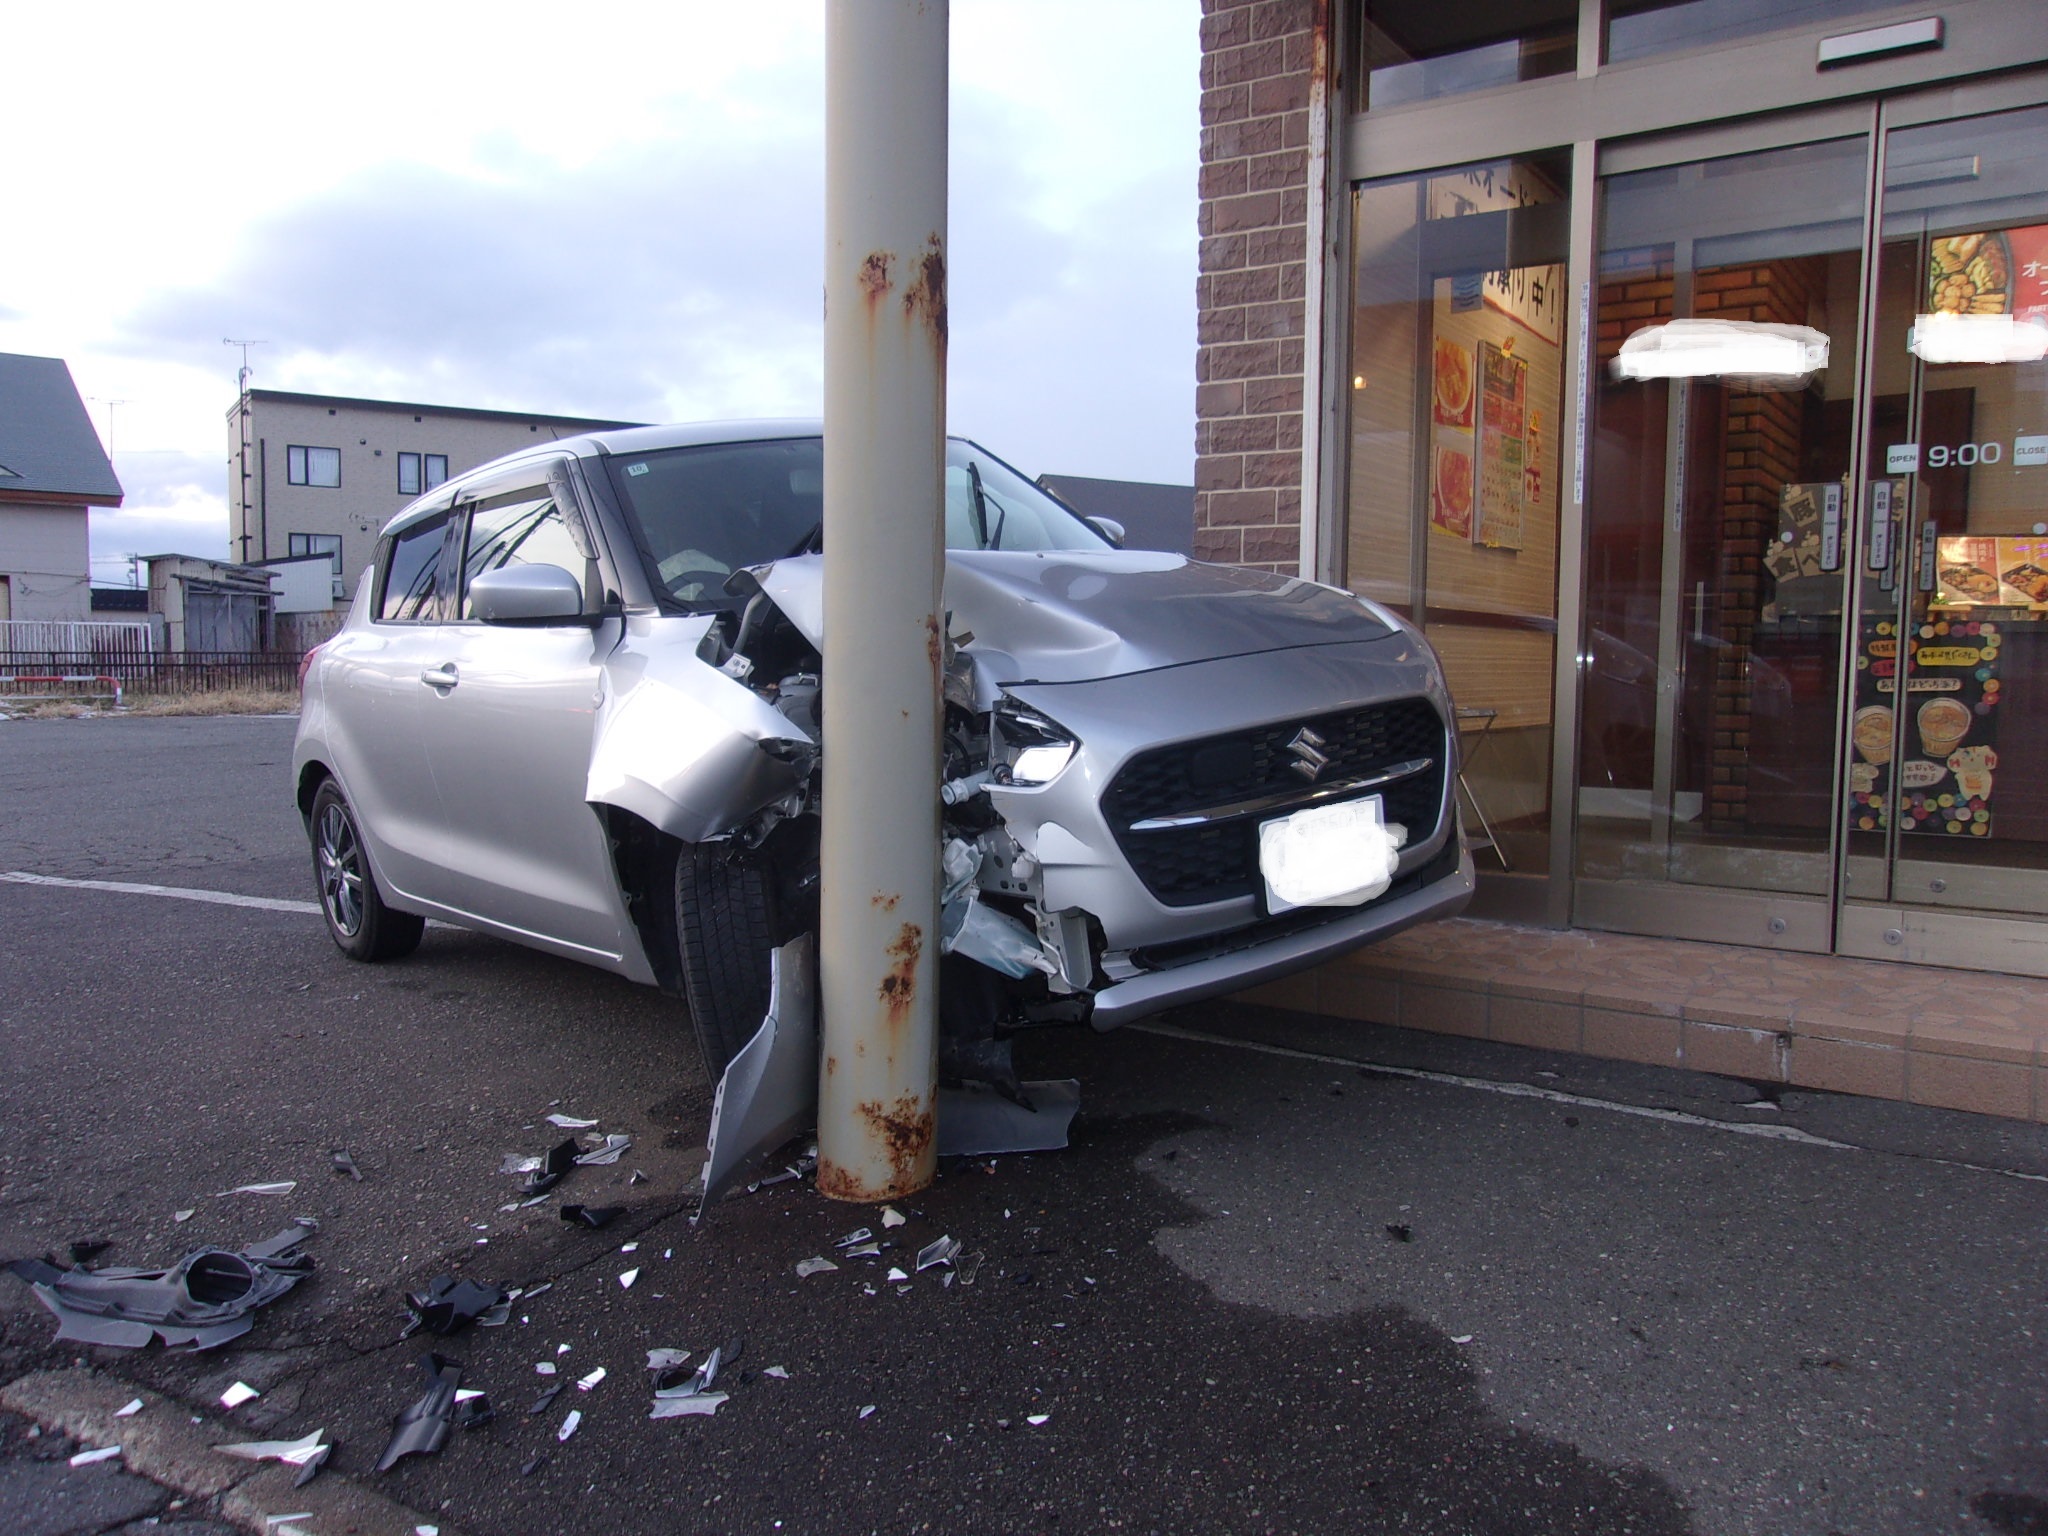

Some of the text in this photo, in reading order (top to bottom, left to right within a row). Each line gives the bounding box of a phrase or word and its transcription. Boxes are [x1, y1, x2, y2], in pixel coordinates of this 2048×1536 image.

[1889, 442, 2047, 468] OPEN 9:00 CLOSE
